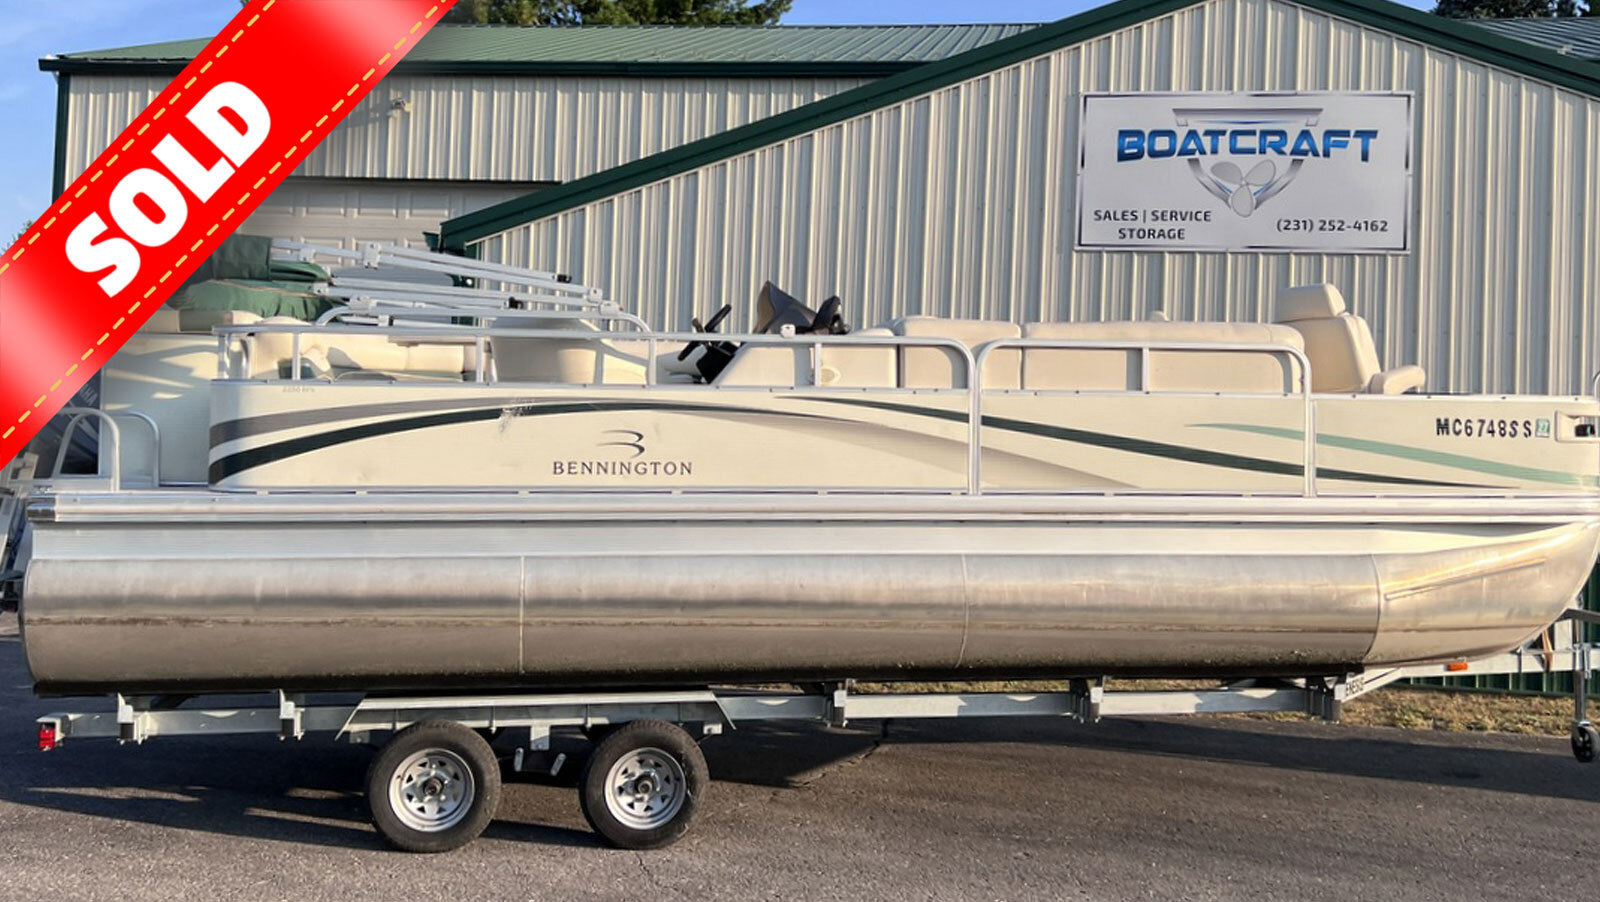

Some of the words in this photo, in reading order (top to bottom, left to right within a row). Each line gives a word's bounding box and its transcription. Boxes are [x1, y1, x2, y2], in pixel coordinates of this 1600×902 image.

[1117, 129, 1378, 162] BOATCRAFT
[1094, 209, 1138, 222] SALES
[1151, 209, 1212, 222] SERVICE
[1276, 218, 1314, 232] (231)
[1318, 219, 1388, 232] 252-4162
[1118, 227, 1186, 240] STORAGE
[553, 461, 693, 476] BENNINGTON
